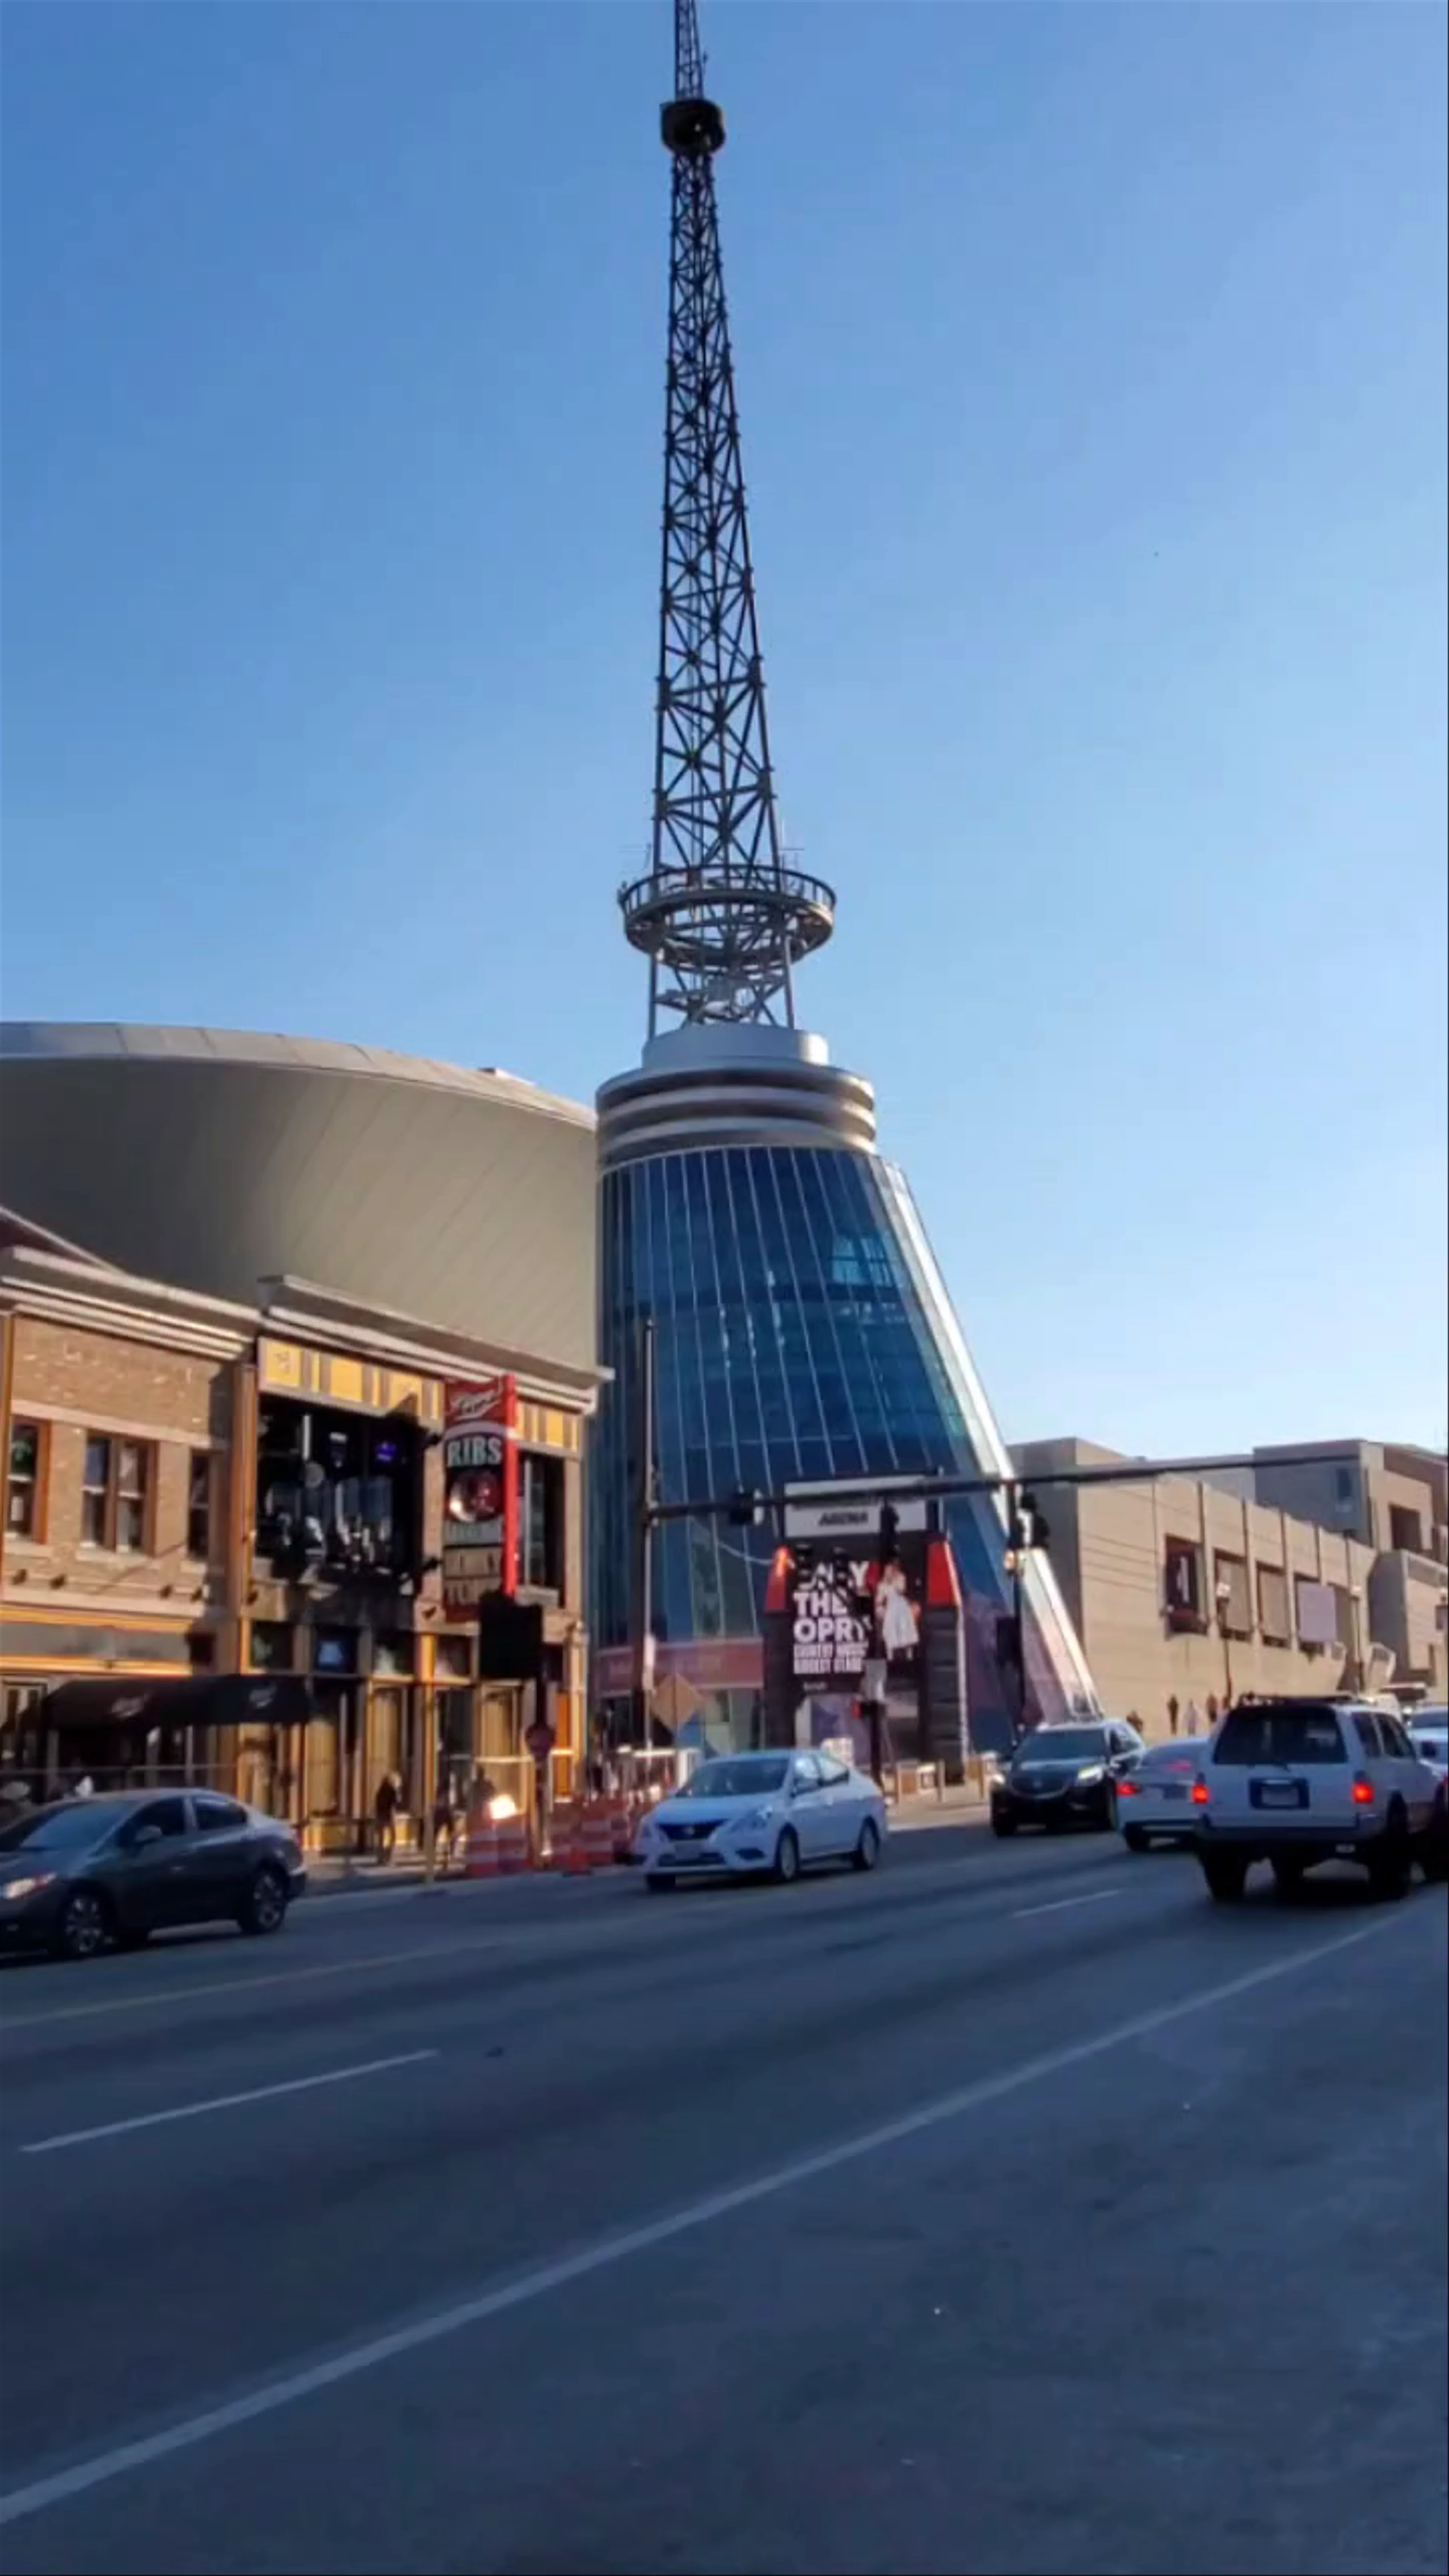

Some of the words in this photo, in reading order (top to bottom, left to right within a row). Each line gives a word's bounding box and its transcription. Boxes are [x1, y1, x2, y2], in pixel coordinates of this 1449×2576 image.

[447, 1436, 502, 1467] RIBS
[793, 1588, 848, 1616] THE
[794, 1616, 872, 1642] OPRY
